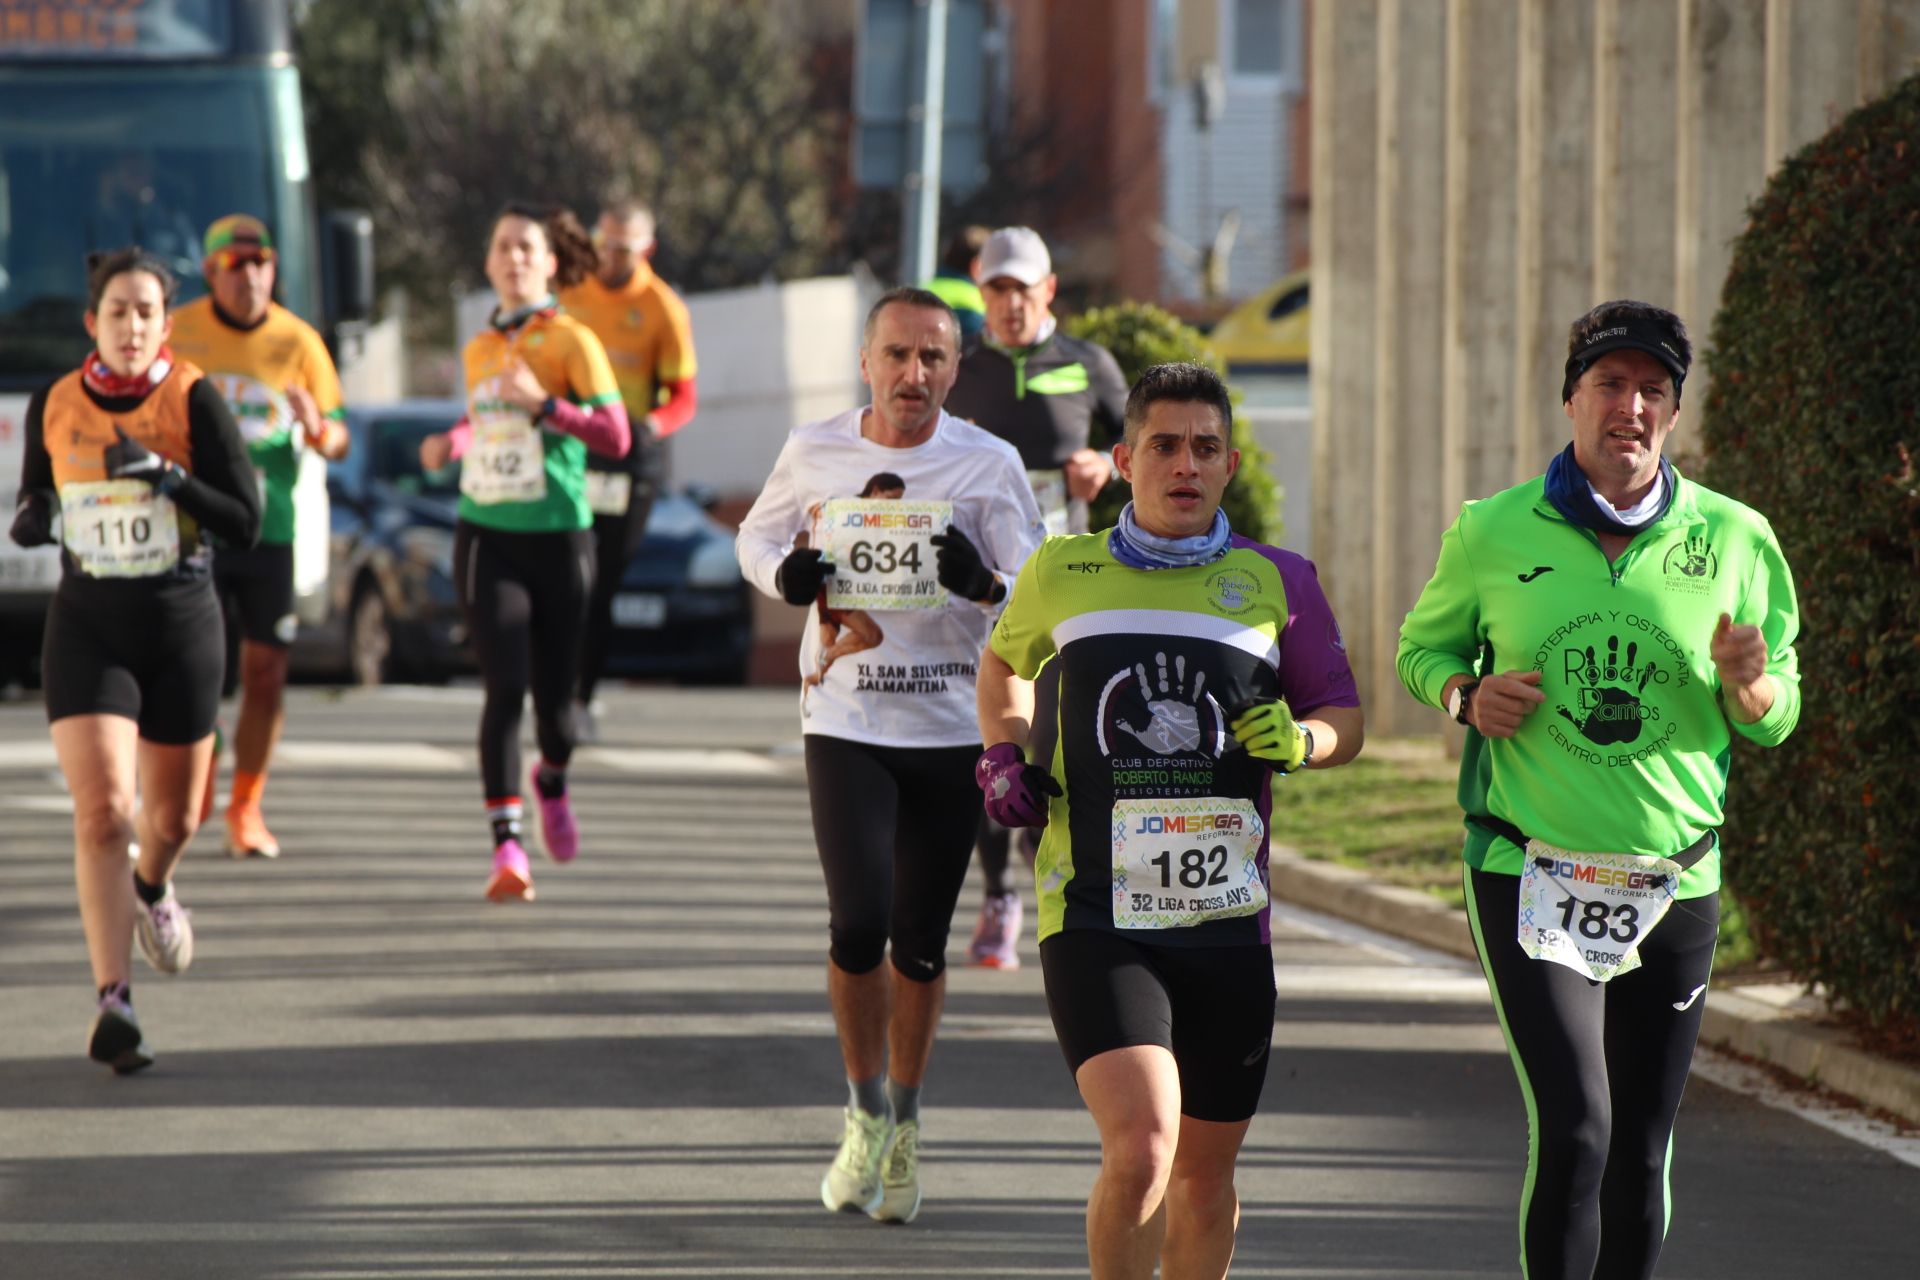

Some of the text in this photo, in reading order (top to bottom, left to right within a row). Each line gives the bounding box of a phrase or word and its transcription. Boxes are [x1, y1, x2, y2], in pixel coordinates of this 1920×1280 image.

[481, 452, 522, 476] 142
[842, 513, 932, 529] JOMISAGA
[93, 516, 151, 546] 110
[850, 540, 922, 574] 634
[1067, 561, 1105, 574] EKT
[836, 579, 853, 594] 32
[881, 583, 913, 595] CROSS
[914, 579, 936, 595] AVS
[1217, 576, 1255, 592] Roberto
[1691, 582, 1711, 592] RAMOS
[1608, 610, 1621, 623] Y
[857, 662, 978, 679] XL SAN SILVESTRE
[1564, 648, 1670, 686] Roberto
[856, 679, 949, 693] SALMANTINA
[1580, 687, 1660, 721] Ramos
[1547, 722, 1677, 768] CENTRO DEPORTIVO
[1111, 758, 1214, 768] CLUB DEPORTIVO
[1112, 770, 1214, 785] ROBERTO RAMOS
[1114, 787, 1213, 796] FISIOTERAPIA
[1135, 813, 1244, 835] JOMISAGA
[1196, 831, 1242, 841] REFORMAS
[1151, 844, 1229, 889] 182
[1131, 893, 1153, 912] 32
[1189, 896, 1226, 912] CROSS
[1225, 886, 1252, 907] AVS
[1604, 887, 1655, 899] REFORMAS
[1555, 894, 1640, 945] 183
